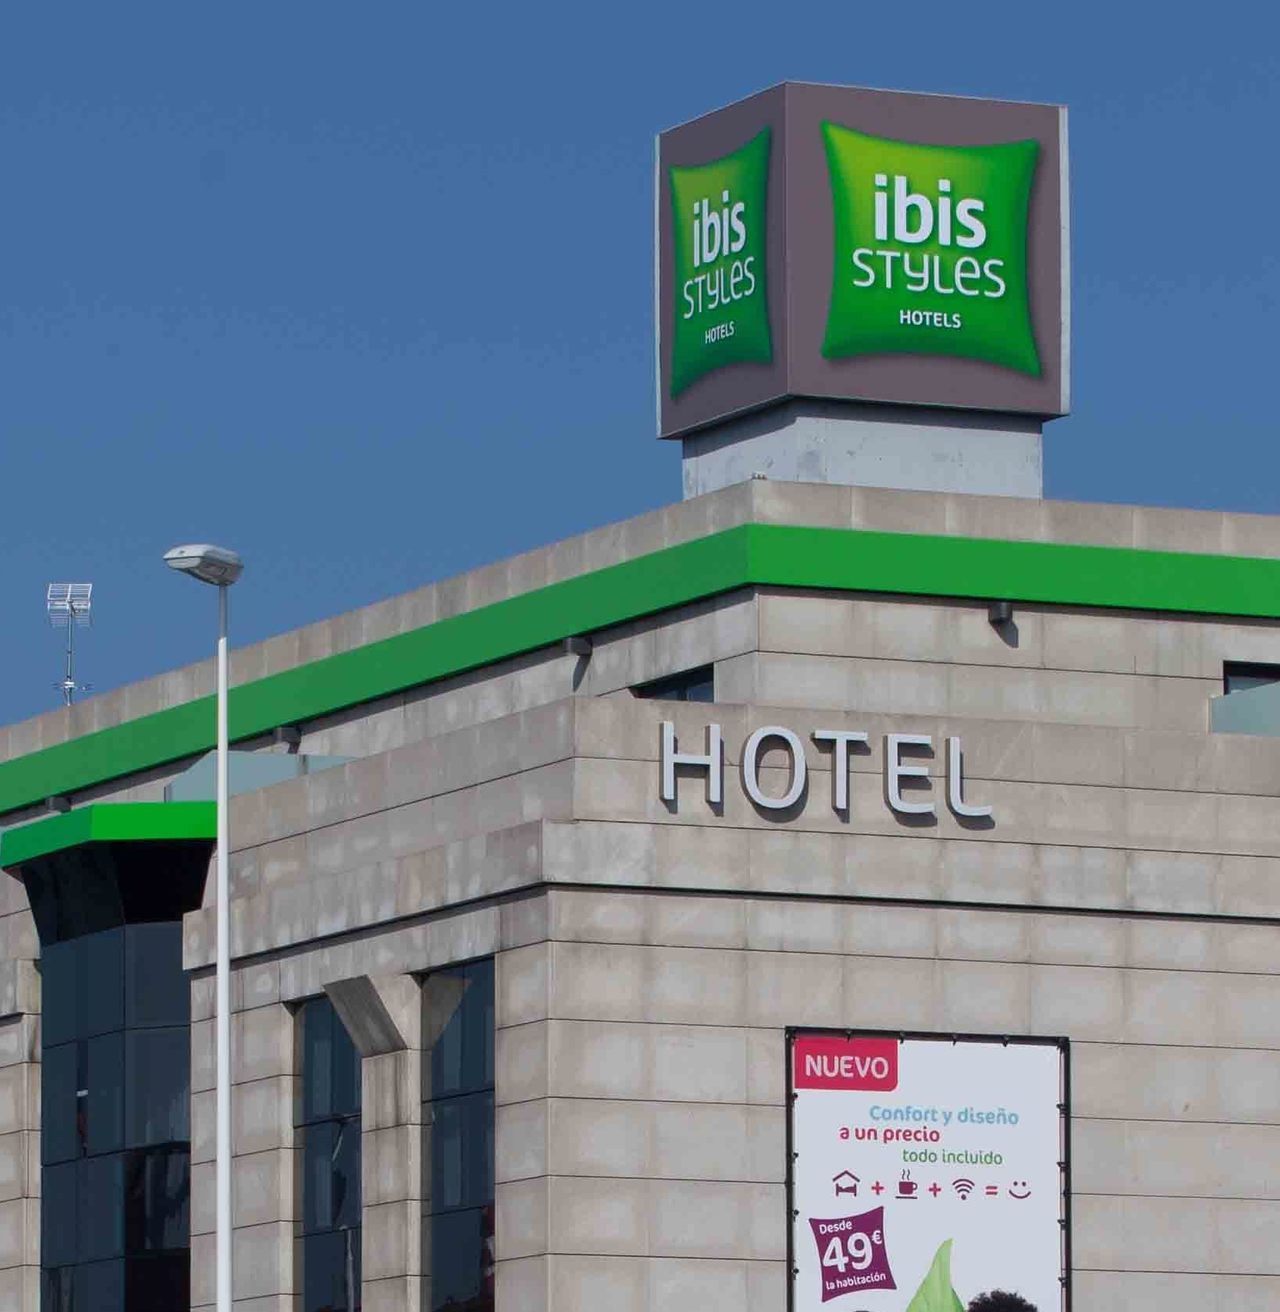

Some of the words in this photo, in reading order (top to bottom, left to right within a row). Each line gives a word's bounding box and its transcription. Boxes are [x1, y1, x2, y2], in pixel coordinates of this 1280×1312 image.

[873, 174, 988, 248] ibis
[693, 190, 747, 269] ibis
[899, 308, 962, 329] HOTELS
[704, 320, 735, 344] HOTELS
[659, 720, 993, 818] HOTEL
[805, 1054, 889, 1079] NUEVO
[869, 1105, 938, 1122] Confort
[943, 1110, 953, 1127] y
[957, 1107, 1019, 1125] diseño
[839, 1126, 850, 1140] a
[855, 1128, 878, 1141] un
[883, 1125, 941, 1144] precio
[903, 1148, 938, 1164] todo
[942, 1148, 1003, 1165] incluido
[819, 1219, 853, 1234] Desde
[825, 1280, 836, 1291] la
[836, 1271, 887, 1290] habitación
